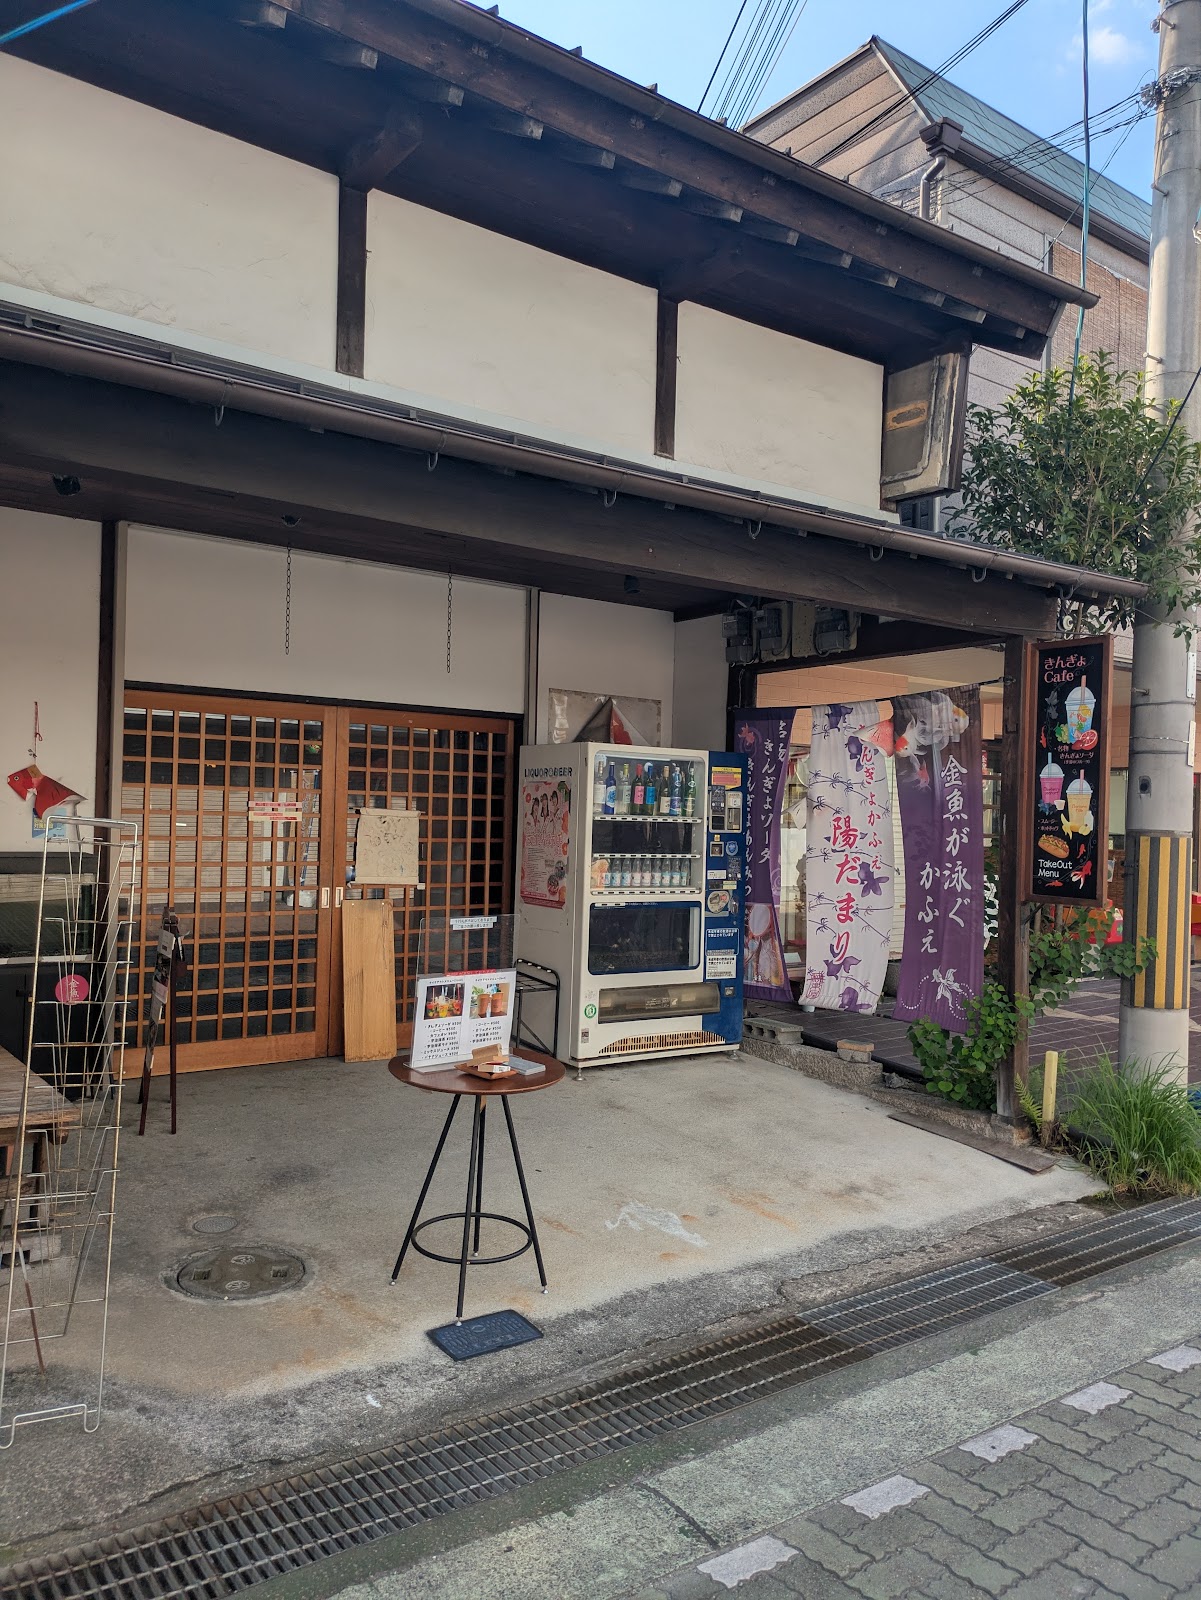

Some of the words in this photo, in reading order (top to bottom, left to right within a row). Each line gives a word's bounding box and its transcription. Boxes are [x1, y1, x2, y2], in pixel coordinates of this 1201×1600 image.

[1044, 653, 1086, 670] きんぎょ
[1043, 670, 1075, 683] Cafe
[940, 753, 971, 928] 金魚が泳ぐ
[1038, 859, 1073, 870] TakeOut
[1038, 868, 1060, 878] Menu
[832, 815, 860, 965] 陽だまり
[919, 861, 940, 954] かふぇ
